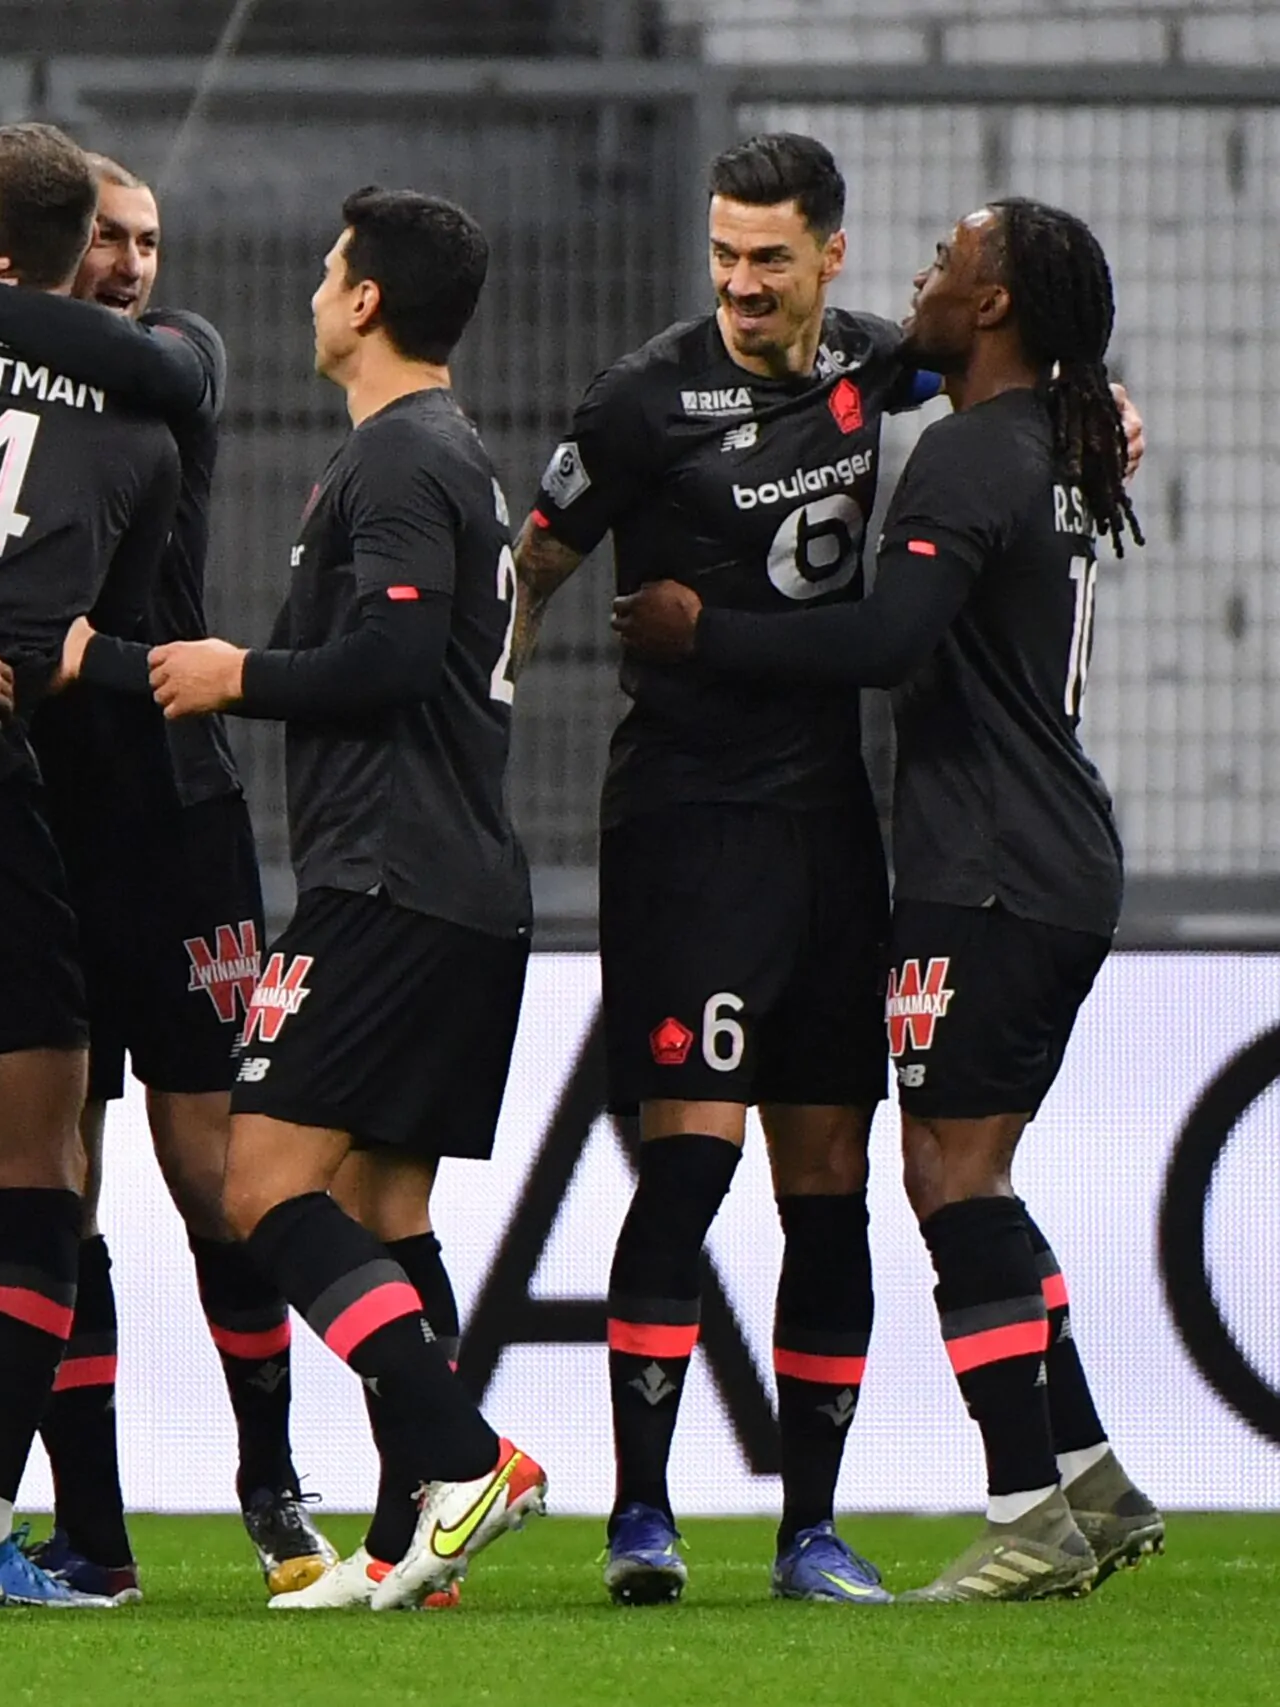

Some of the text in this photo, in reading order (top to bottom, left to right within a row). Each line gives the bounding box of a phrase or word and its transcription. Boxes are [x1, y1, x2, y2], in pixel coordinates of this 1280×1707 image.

[697, 386, 753, 410] RIKA
[732, 449, 872, 510] boulanger
[702, 992, 744, 1072] 6
